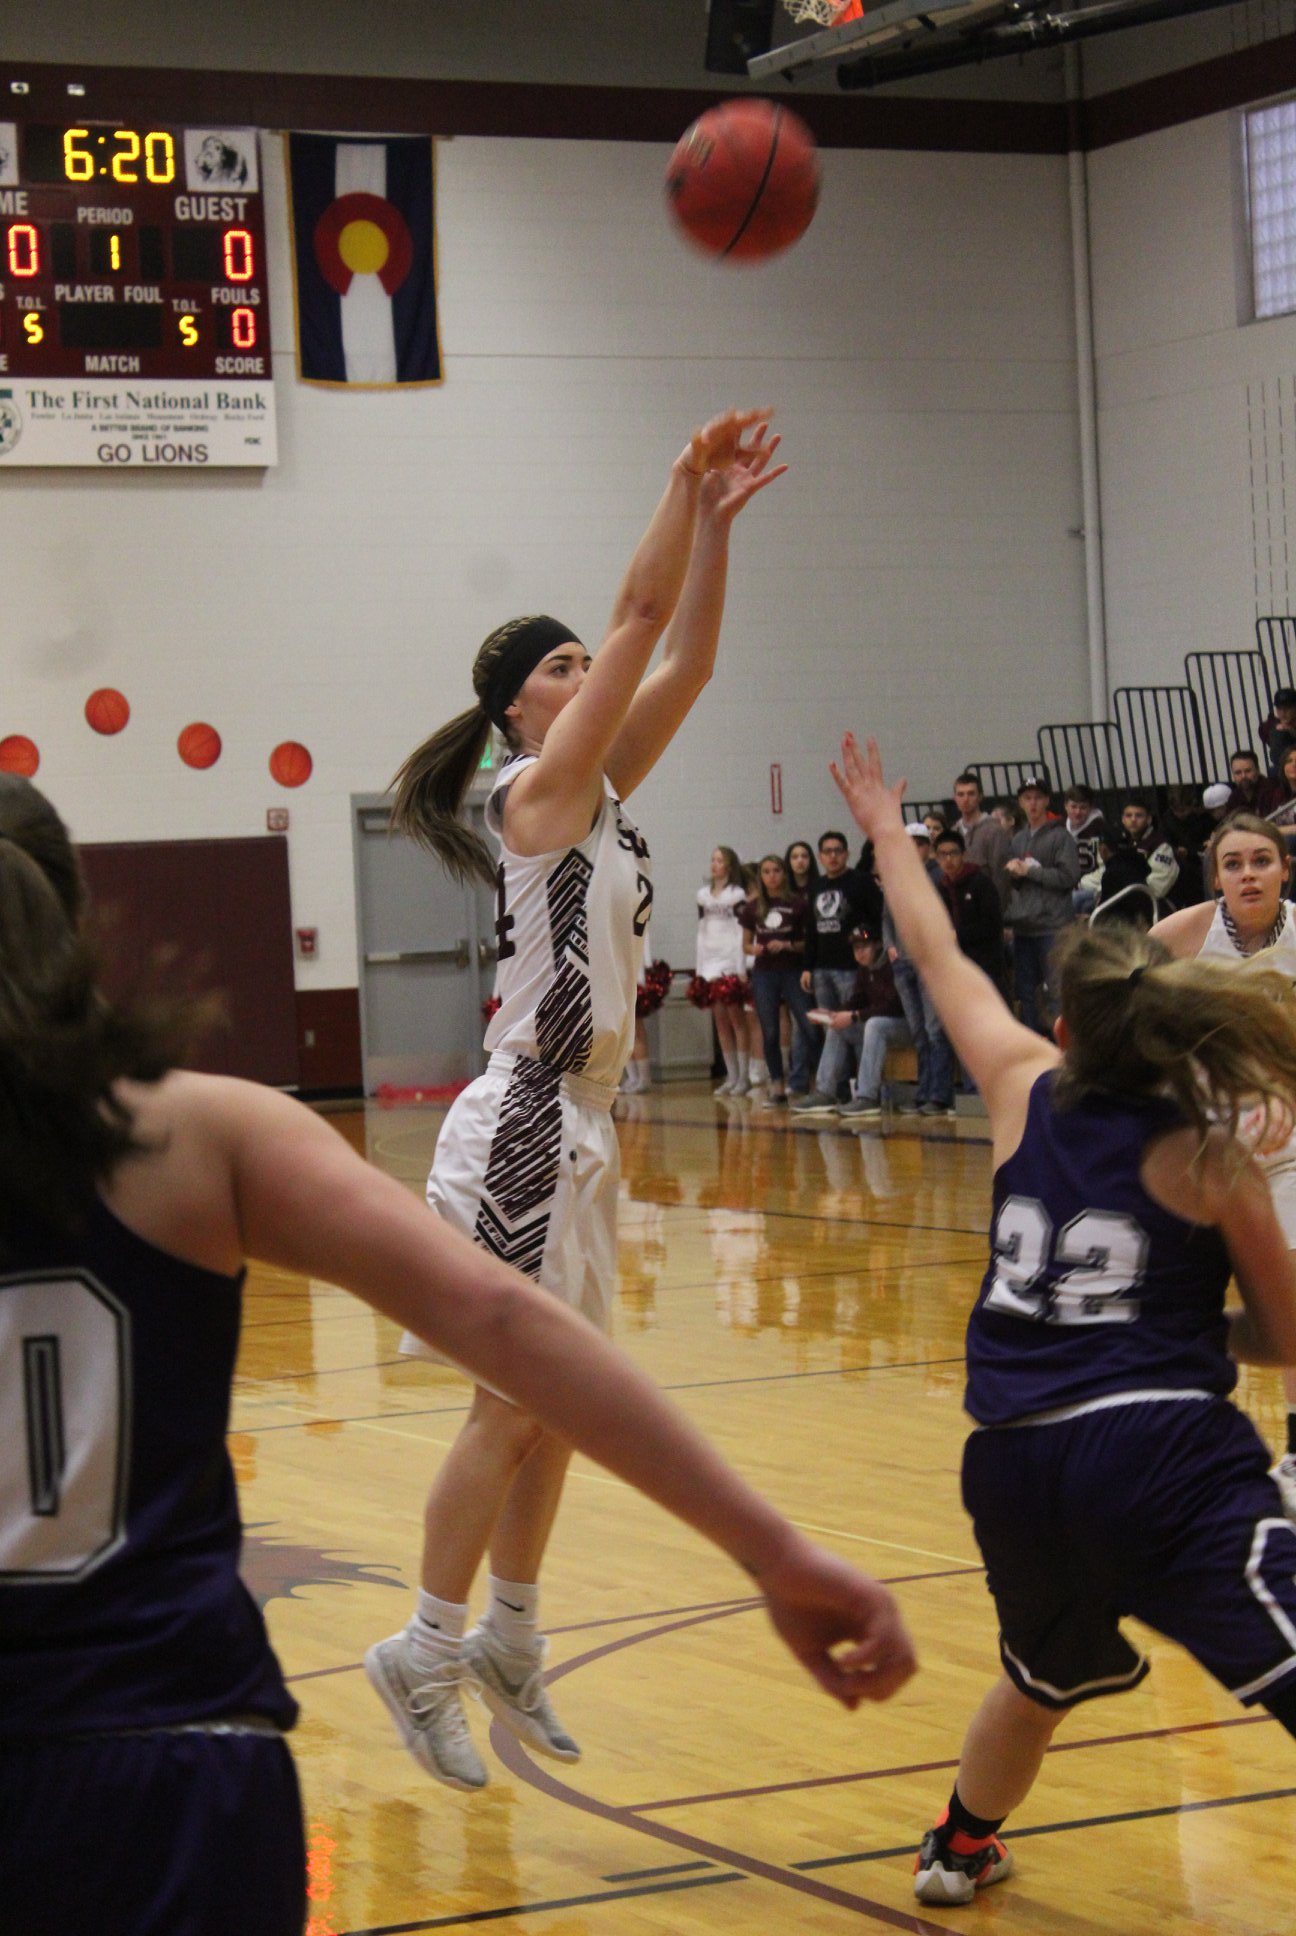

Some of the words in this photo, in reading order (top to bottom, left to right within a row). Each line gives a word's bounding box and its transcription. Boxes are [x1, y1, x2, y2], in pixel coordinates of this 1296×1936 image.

[64, 129, 175, 183] 6:20
[77, 206, 134, 225] PERIOD
[174, 196, 248, 222] GUEST
[8, 224, 38, 277] 0
[110, 235, 120, 270] 1
[224, 230, 253, 281] 0
[54, 284, 115, 302] PLAYER
[124, 285, 163, 303] FOUL
[211, 287, 261, 306] FOULS
[23, 312, 44, 345] 5
[178, 315, 199, 347] 5
[231, 308, 256, 348] 0
[85, 355, 141, 373] MATCH
[215, 356, 265, 374] SCORE
[26, 390, 65, 409] The
[72, 391, 118, 410] First
[126, 391, 209, 410] National
[216, 392, 267, 411] Bank
[97, 443, 132, 463] GO
[142, 443, 210, 463] LIONS
[983, 1194, 1150, 1326] 22
